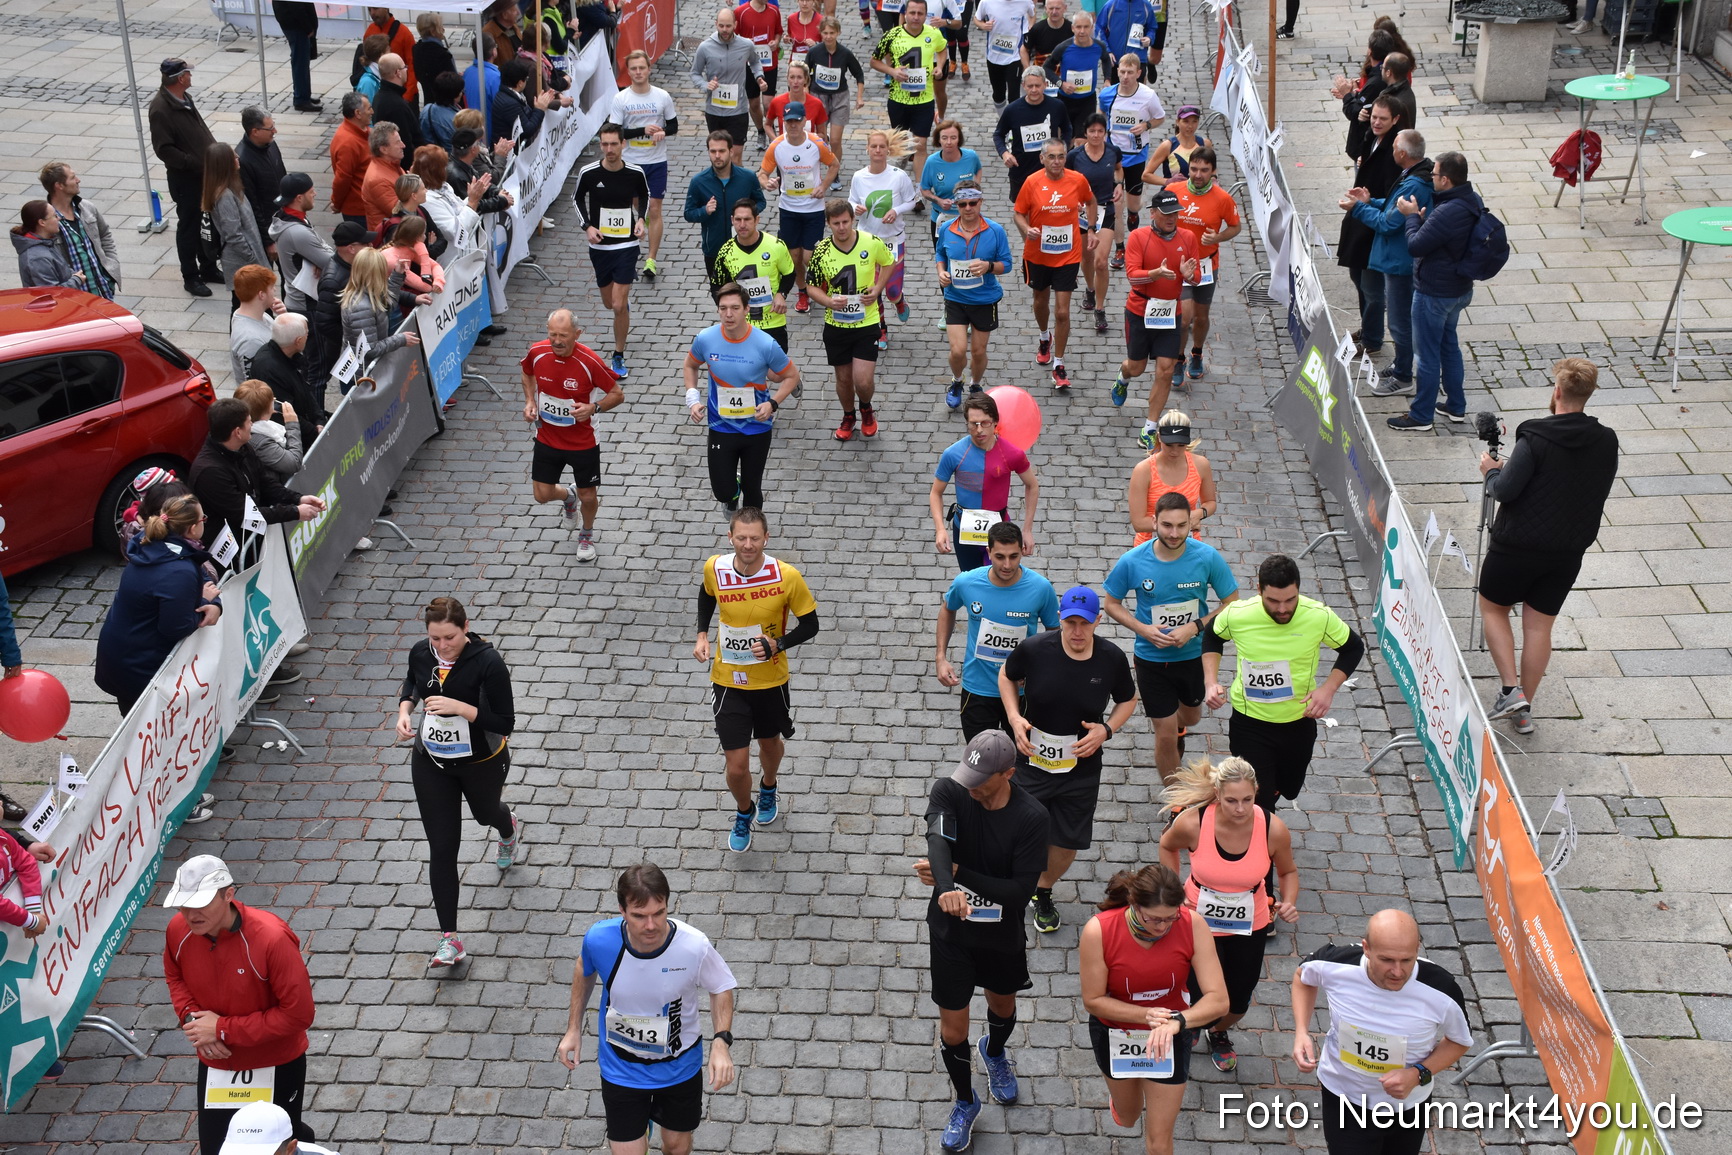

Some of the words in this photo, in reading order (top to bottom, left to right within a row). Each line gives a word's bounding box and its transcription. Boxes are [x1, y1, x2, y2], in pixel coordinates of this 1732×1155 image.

[995, 39, 1014, 49] 2306
[818, 72, 837, 84] 2239
[905, 75, 924, 84] 666
[1074, 78, 1084, 86] 88
[718, 90, 731, 100] 141
[637, 102, 657, 110] BANK
[1115, 115, 1136, 125] 2028
[1026, 131, 1047, 143] 2129
[794, 181, 805, 190] 86
[607, 217, 625, 228] 130
[1046, 233, 1069, 244] 2949
[955, 268, 975, 279] 272
[746, 286, 767, 298] 694
[1150, 307, 1172, 318] 2730
[338, 359, 352, 377] swn
[729, 397, 743, 407] 44
[544, 402, 570, 417] 2318
[974, 519, 990, 531] 37
[972, 533, 989, 541] Gerhar
[216, 541, 231, 560] swn
[1176, 581, 1200, 590] BOCK
[719, 592, 747, 604] MAX
[750, 586, 785, 601] BÖGL
[1006, 610, 1031, 619] BOCK
[1159, 612, 1194, 628] 2527
[725, 637, 757, 651] 2620
[983, 633, 1019, 649] 2055
[732, 652, 755, 660] Bern
[1248, 672, 1284, 688] 2456
[428, 726, 461, 743] 2621
[1039, 744, 1063, 759] 291
[32, 805, 54, 832] swn
[1551, 848, 1568, 871] swn
[1204, 903, 1246, 919] 2578
[93, 893, 141, 977] Service-Line:
[1528, 933, 1540, 949] die
[1531, 914, 1554, 963] Neumarkts
[1552, 959, 1573, 1003] moderner
[614, 1022, 658, 1045] 2413
[1119, 1043, 1156, 1056] 204
[1354, 1040, 1389, 1061] 145
[1356, 1058, 1385, 1071] Stephan
[230, 1069, 254, 1085] 70
[228, 1089, 251, 1099] Harald
[236, 1128, 263, 1136] OLYMP
